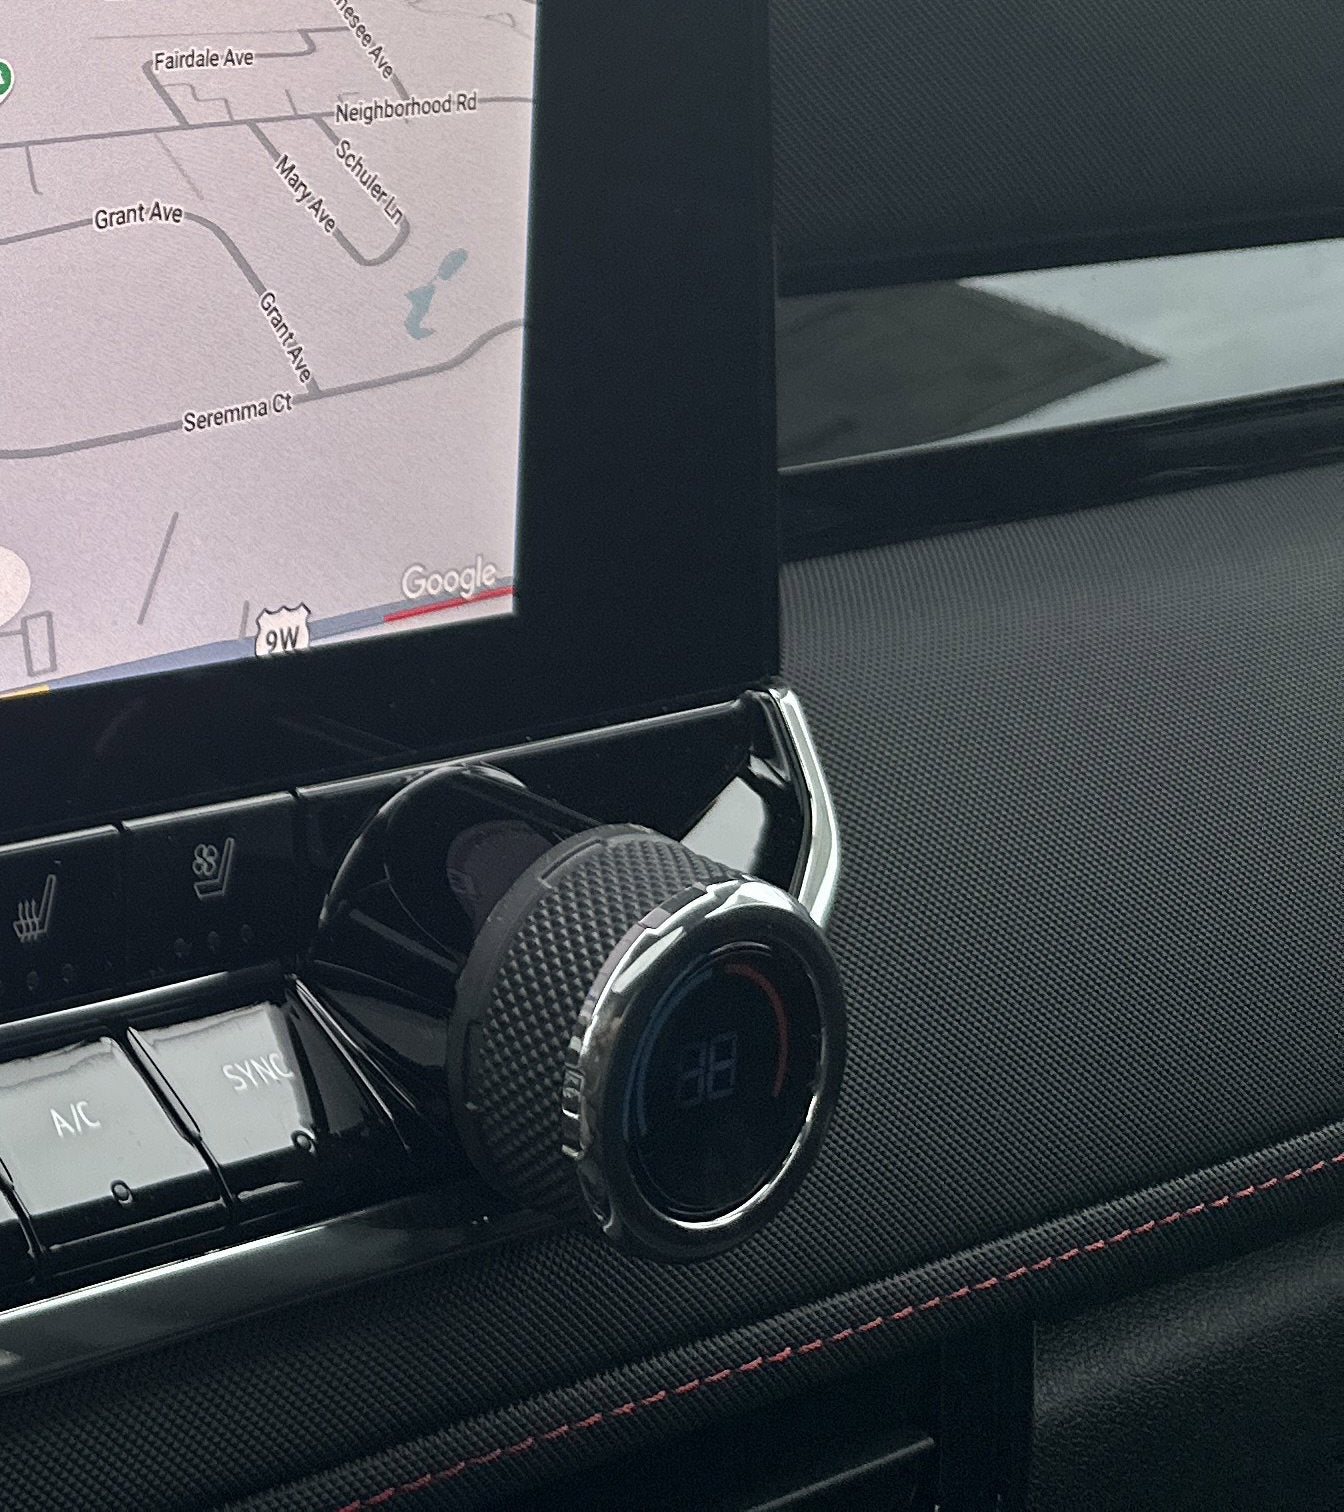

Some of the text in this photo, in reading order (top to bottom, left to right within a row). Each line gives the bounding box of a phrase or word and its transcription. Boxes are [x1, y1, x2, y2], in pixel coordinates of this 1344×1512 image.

[154, 49, 253, 70] Fairdale Ave
[369, 46, 393, 79] Ave
[336, 92, 477, 125] Neighborhood Rd
[276, 155, 336, 233] Mary Ave
[336, 140, 403, 224] Schuler Ln
[94, 204, 183, 229] Grant Ave
[259, 291, 311, 383] Grant Ave
[184, 394, 293, 431] Seremma Ct
[401, 555, 498, 600] Google
[265, 623, 301, 652] 9W
[222, 1052, 295, 1091] SYNC
[50, 1099, 100, 1138] A/C
